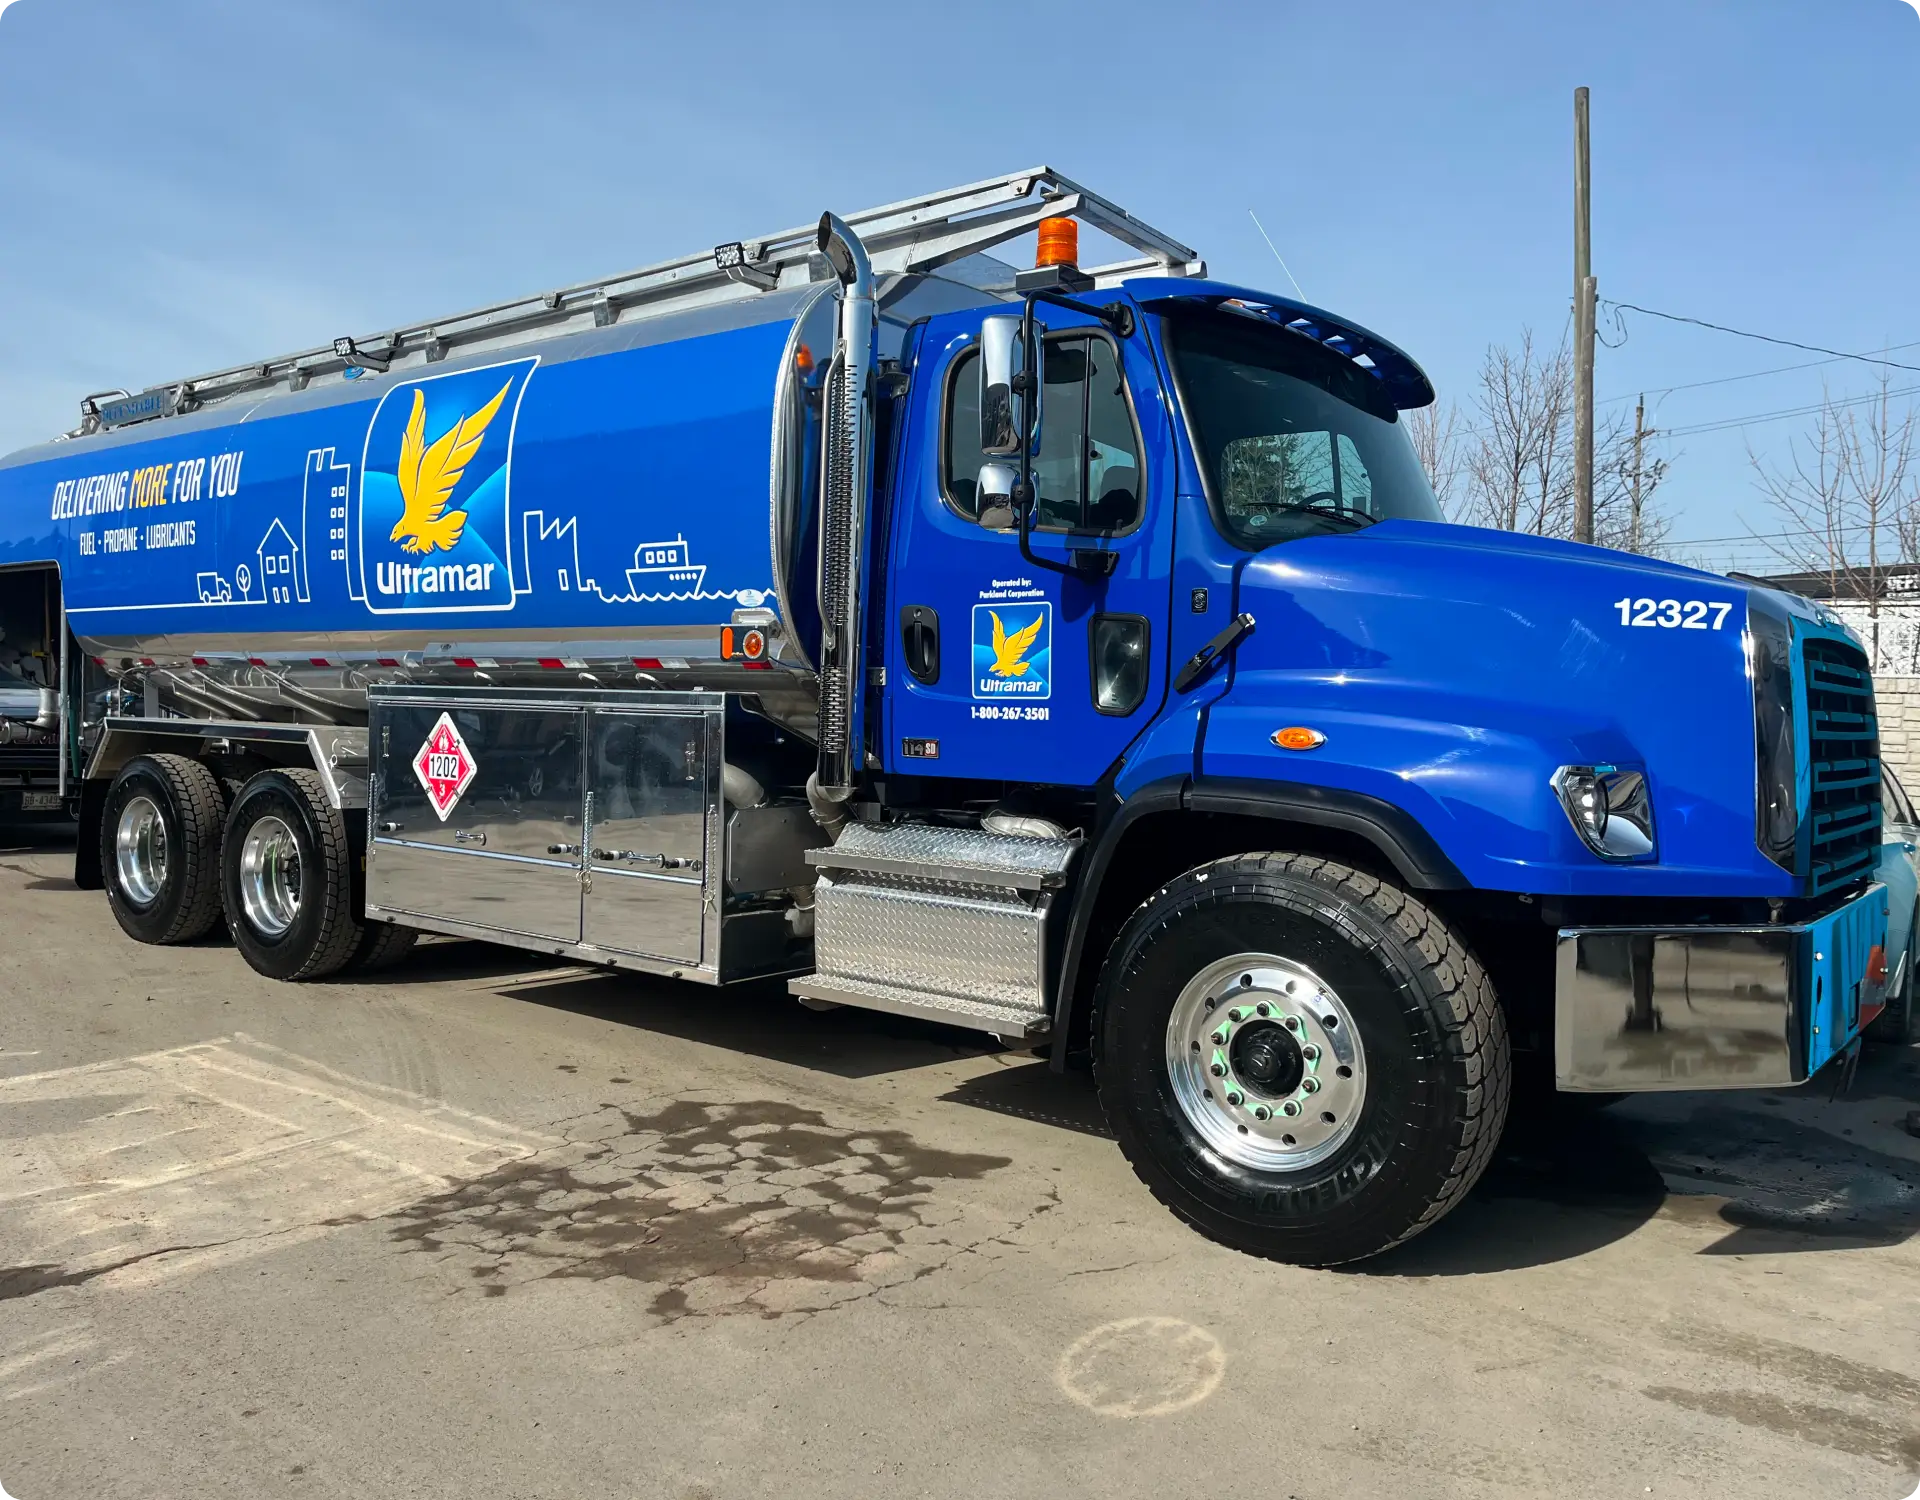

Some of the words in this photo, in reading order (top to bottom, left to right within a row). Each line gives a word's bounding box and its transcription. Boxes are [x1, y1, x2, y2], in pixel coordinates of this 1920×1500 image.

[51, 470, 130, 521] DELIVERING
[128, 463, 173, 509] MORE
[171, 457, 206, 504] FOR
[208, 450, 244, 499] YOU
[79, 532, 97, 556] FUEL
[103, 526, 139, 554] PROPANE
[145, 520, 197, 550] LUBRICANTS
[376, 561, 495, 595] Ultramar
[979, 589, 1007, 599] Parkland
[1007, 588, 1044, 599] Corporation
[1613, 597, 1732, 631] 12327
[980, 679, 1043, 692] Ultramar
[970, 706, 1050, 720] 1-800-267-3501
[925, 742, 936, 755] SD
[430, 755, 458, 779] 1202
[438, 782, 446, 798] 3
